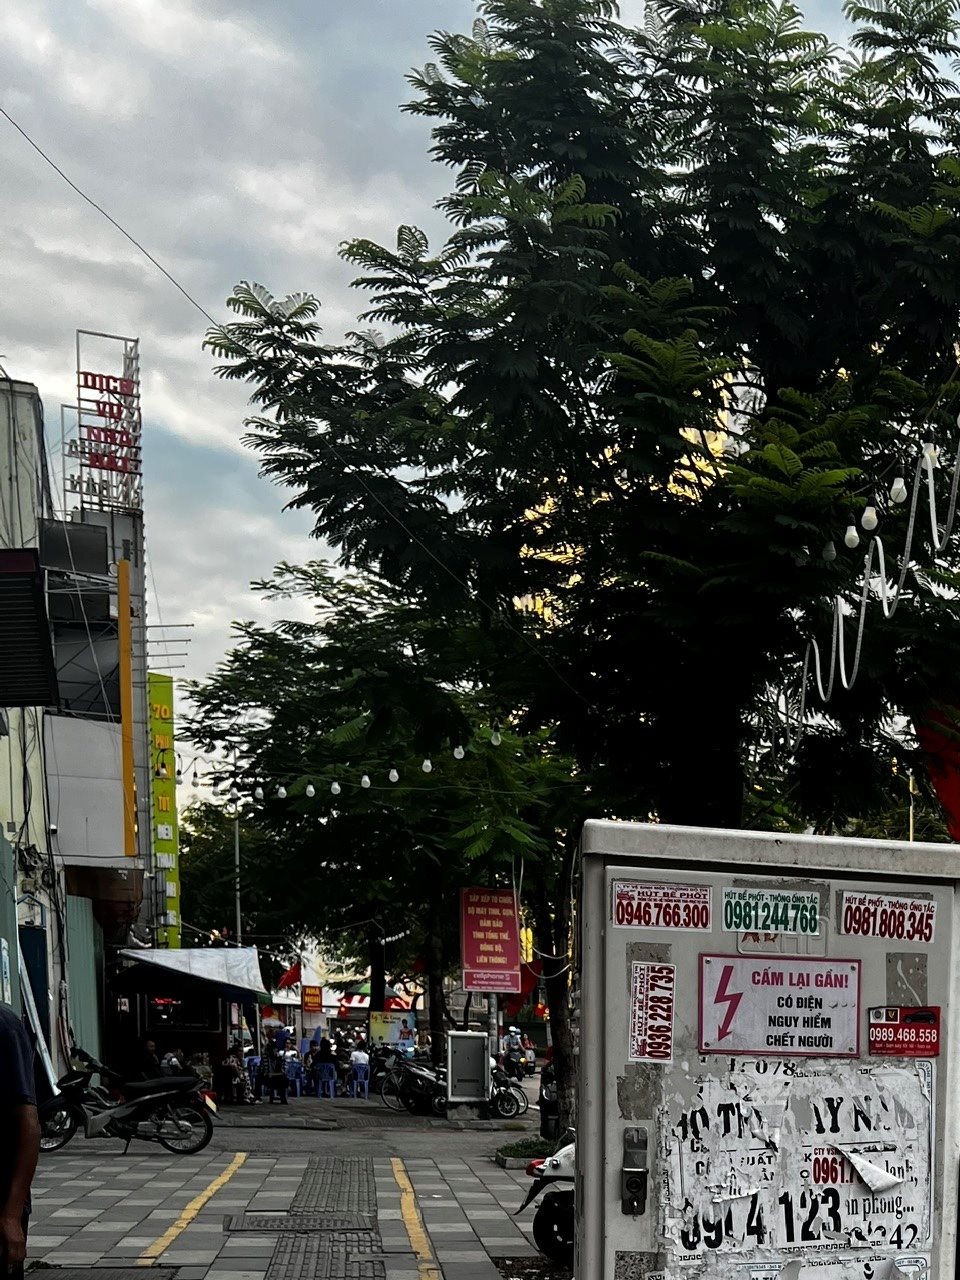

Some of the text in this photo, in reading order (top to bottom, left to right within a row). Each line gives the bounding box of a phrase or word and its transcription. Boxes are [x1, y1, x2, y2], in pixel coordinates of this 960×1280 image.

[724, 890, 736, 900] HÚT
[748, 892, 764, 902] PHỐT
[770, 893, 790, 903] THÔNG
[792, 893, 805, 904] ỐNG
[806, 894, 818, 905] TẮC
[845, 895, 857, 905] HÚT
[868, 897, 883, 908] PHỐT
[888, 900, 908, 911] THÔNG
[909, 901, 922, 912] ỐNG
[923, 902, 935, 913] TẮC
[616, 901, 709, 928] 0946.766.300
[724, 900, 818, 934] 0981.244.768
[844, 905, 934, 943] 0981.808.345
[751, 966, 849, 990] CẤM LẠI GẦN!
[647, 966, 675, 1058] 0936.228.735
[777, 994, 823, 1012] CÓ ĐIỆN
[768, 1012, 832, 1029] NGUY HIỂM
[766, 1031, 833, 1048] CHẾT NGƯỜI
[869, 1027, 938, 1043] 0989.468.558
